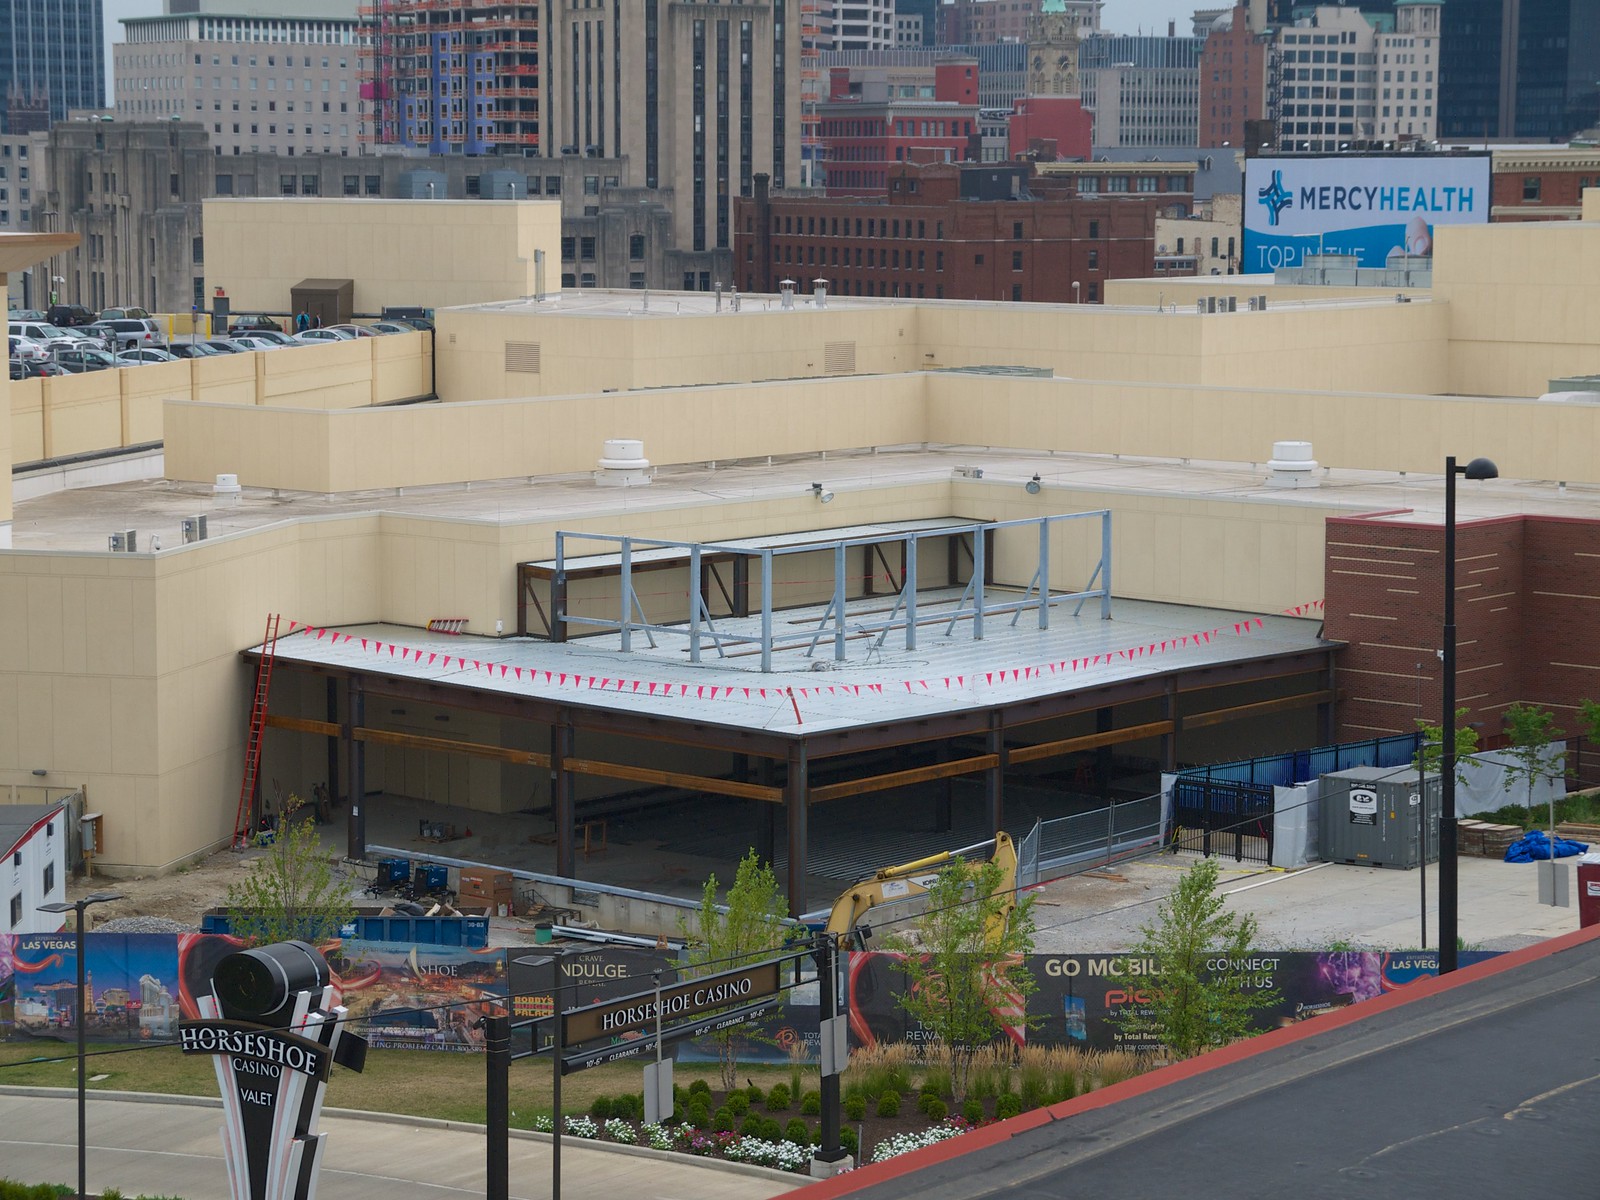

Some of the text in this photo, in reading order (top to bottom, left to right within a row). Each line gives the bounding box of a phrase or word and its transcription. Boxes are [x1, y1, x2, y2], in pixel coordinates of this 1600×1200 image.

[1257, 245, 1295, 269] TOP
[22, 941, 77, 950] LAS VEGAS
[1045, 959, 1081, 977] GO
[1206, 958, 1280, 971] CONNECT
[1392, 960, 1411, 970] LAS
[420, 965, 458, 977] SHOE
[1255, 976, 1273, 988] US
[514, 995, 554, 1003] BOBBY'S
[601, 978, 752, 1031] HORSESHOE CASINO
[514, 1009, 554, 1017] PALACE
[716, 1015, 745, 1030] CLEARANCE
[1114, 1033, 1122, 1041] by
[180, 1027, 317, 1076] HORSESHOE
[393, 1042, 429, 1050] PROBLEM?
[1124, 1044, 1136, 1052] stay
[609, 1047, 639, 1061] CLEARANCE
[233, 1058, 280, 1078] CASINO
[240, 1088, 273, 1106] VALET
